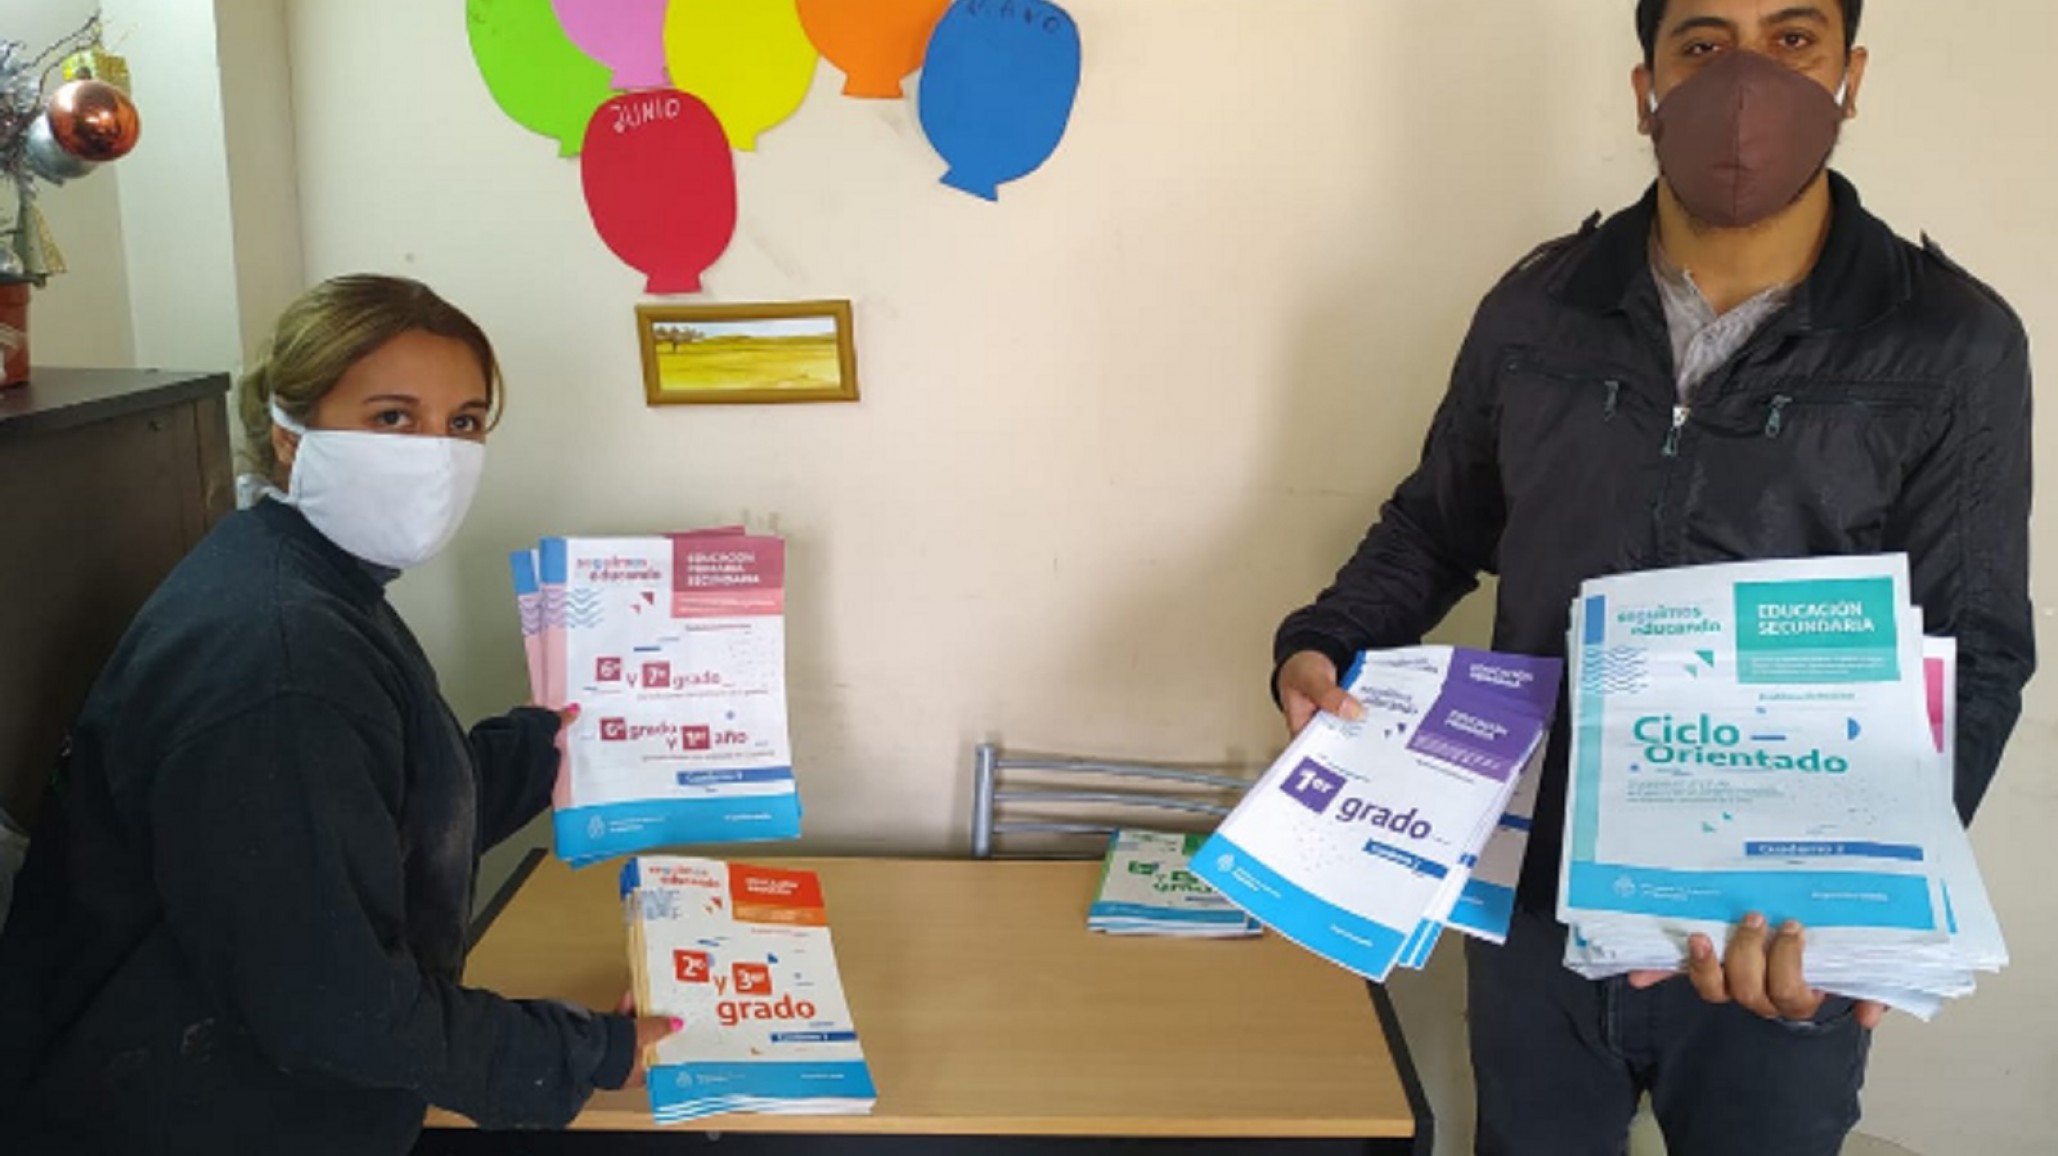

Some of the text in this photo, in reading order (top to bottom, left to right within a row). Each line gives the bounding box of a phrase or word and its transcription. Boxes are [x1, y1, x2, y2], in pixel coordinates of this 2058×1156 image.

[610, 97, 680, 133] JUNIO
[1617, 604, 1702, 625] seguimos
[1758, 600, 1862, 619] EDUCACIÓN
[1630, 619, 1721, 636] educando
[1758, 619, 1875, 636] SECUNDARIA
[673, 670, 722, 690] grado
[714, 729, 748, 745] año
[1633, 714, 1740, 746] Ciclo
[1644, 745, 1849, 774] Orientado
[1295, 769, 1336, 794] 1er
[1335, 796, 1432, 840] grado
[713, 974, 728, 996] y
[716, 993, 817, 1027] grado
